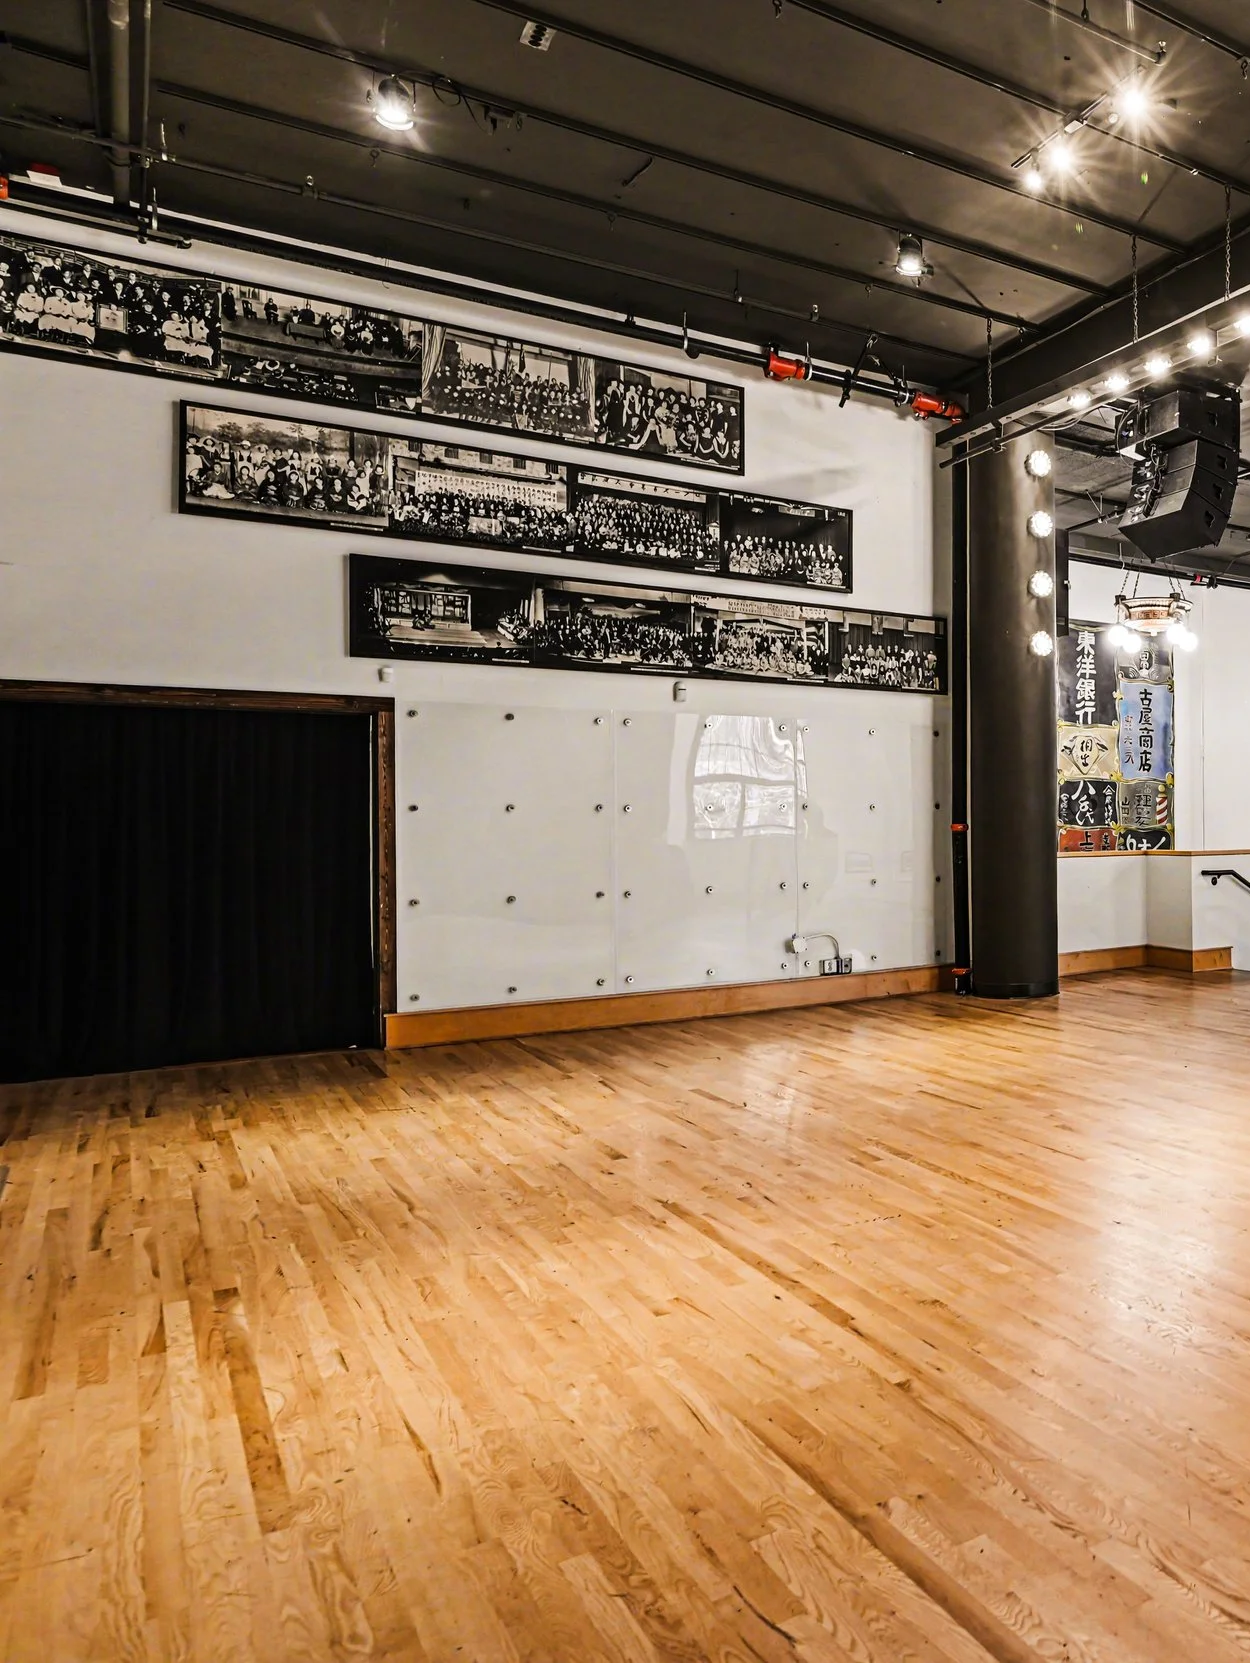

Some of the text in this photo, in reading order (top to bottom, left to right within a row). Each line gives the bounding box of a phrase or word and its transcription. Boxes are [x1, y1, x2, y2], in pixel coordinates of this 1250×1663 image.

[1075, 630, 1097, 726] 東洋銀行
[1138, 688, 1155, 773] 古屋商店
